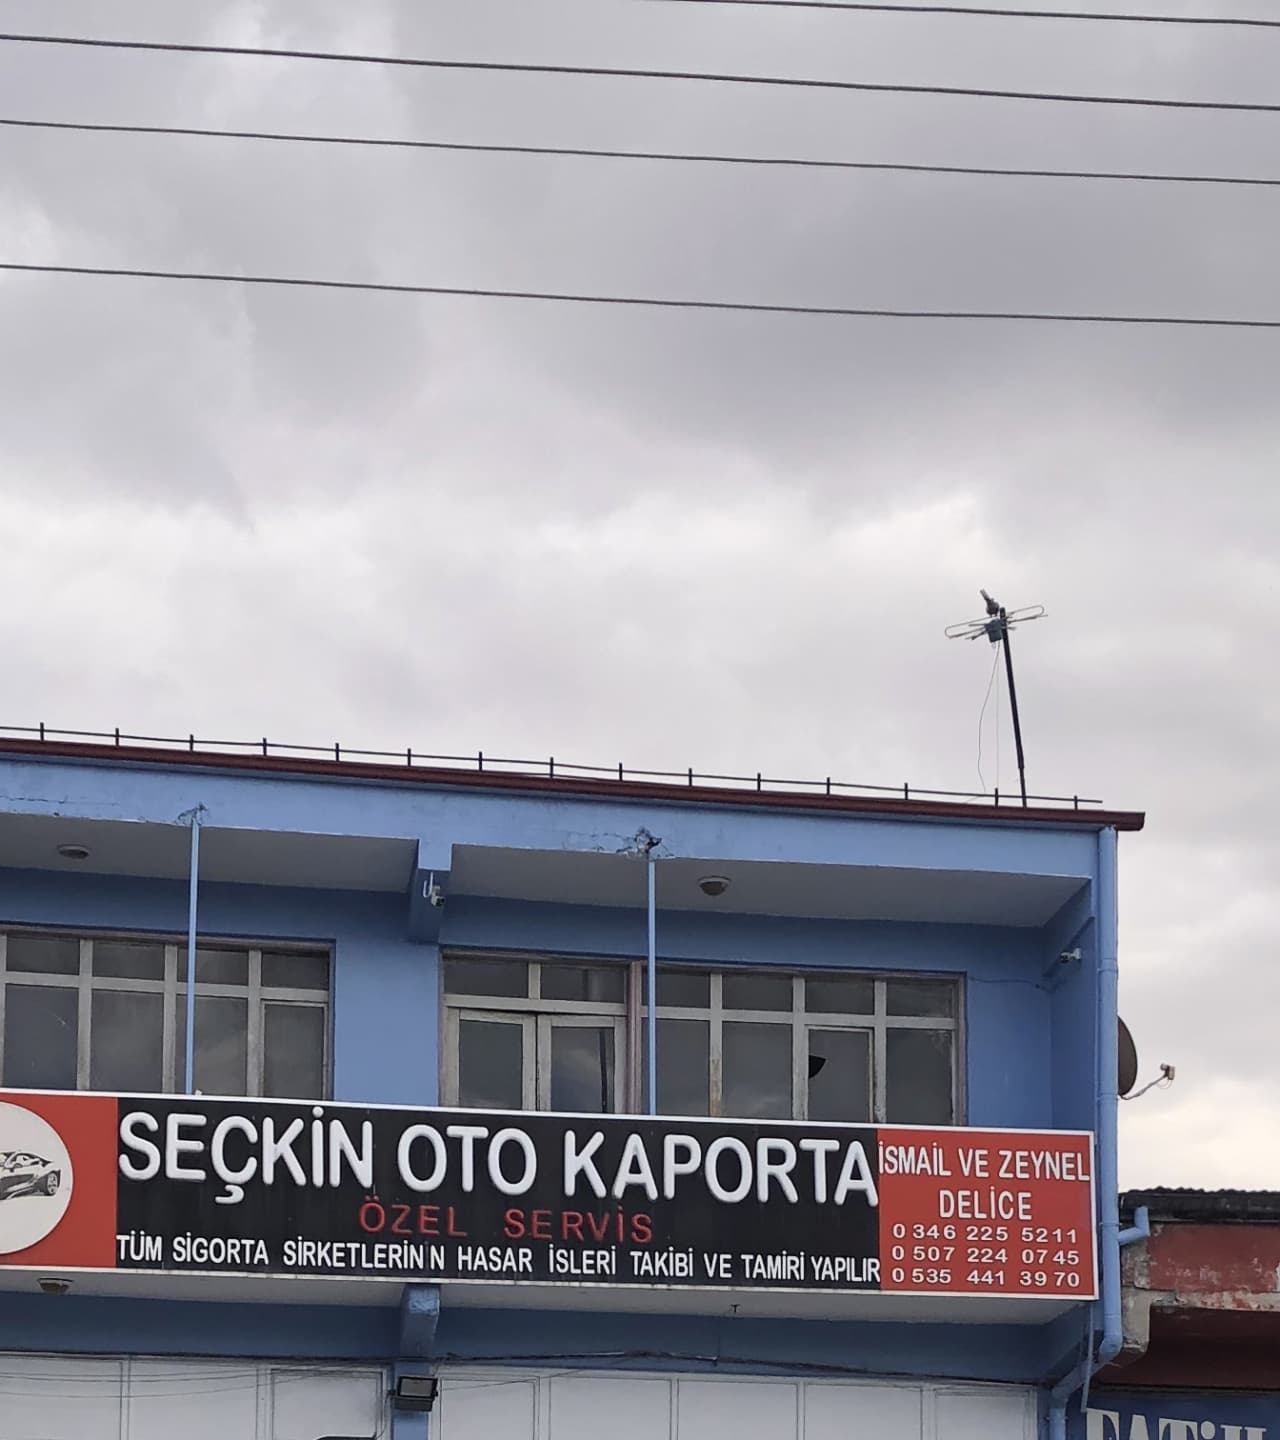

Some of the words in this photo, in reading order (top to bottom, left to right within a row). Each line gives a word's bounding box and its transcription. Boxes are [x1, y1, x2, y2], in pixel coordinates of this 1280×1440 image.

[119, 1105, 374, 1205] SEÇKİN
[397, 1123, 538, 1195] OTO
[564, 1129, 879, 1207] KAPORTA
[878, 1140, 952, 1176] İSMAİL
[958, 1148, 990, 1178] VE
[998, 1150, 1091, 1181] ZEYNEL
[359, 1195, 468, 1238] ÖZEL
[503, 1206, 653, 1244] SERVİS
[939, 1186, 1033, 1221] DELİCE
[892, 1223, 906, 1239] 0
[912, 1224, 957, 1240] 346
[966, 1226, 1009, 1242] 225
[116, 1230, 163, 1262] TÜM
[172, 1231, 269, 1265] SİGORTA
[457, 1245, 533, 1273] HASAR
[630, 1246, 694, 1277] TAKİBİ
[703, 1253, 733, 1279] VE
[740, 1250, 805, 1280] TAMİRİ
[810, 1255, 881, 1283] YAPILIR
[891, 1245, 905, 1261] 0
[912, 1246, 955, 1262] 507
[967, 1247, 1009, 1263] 224
[891, 1267, 905, 1283] 0
[911, 1268, 953, 1284] 535
[966, 1269, 1006, 1285] 441
